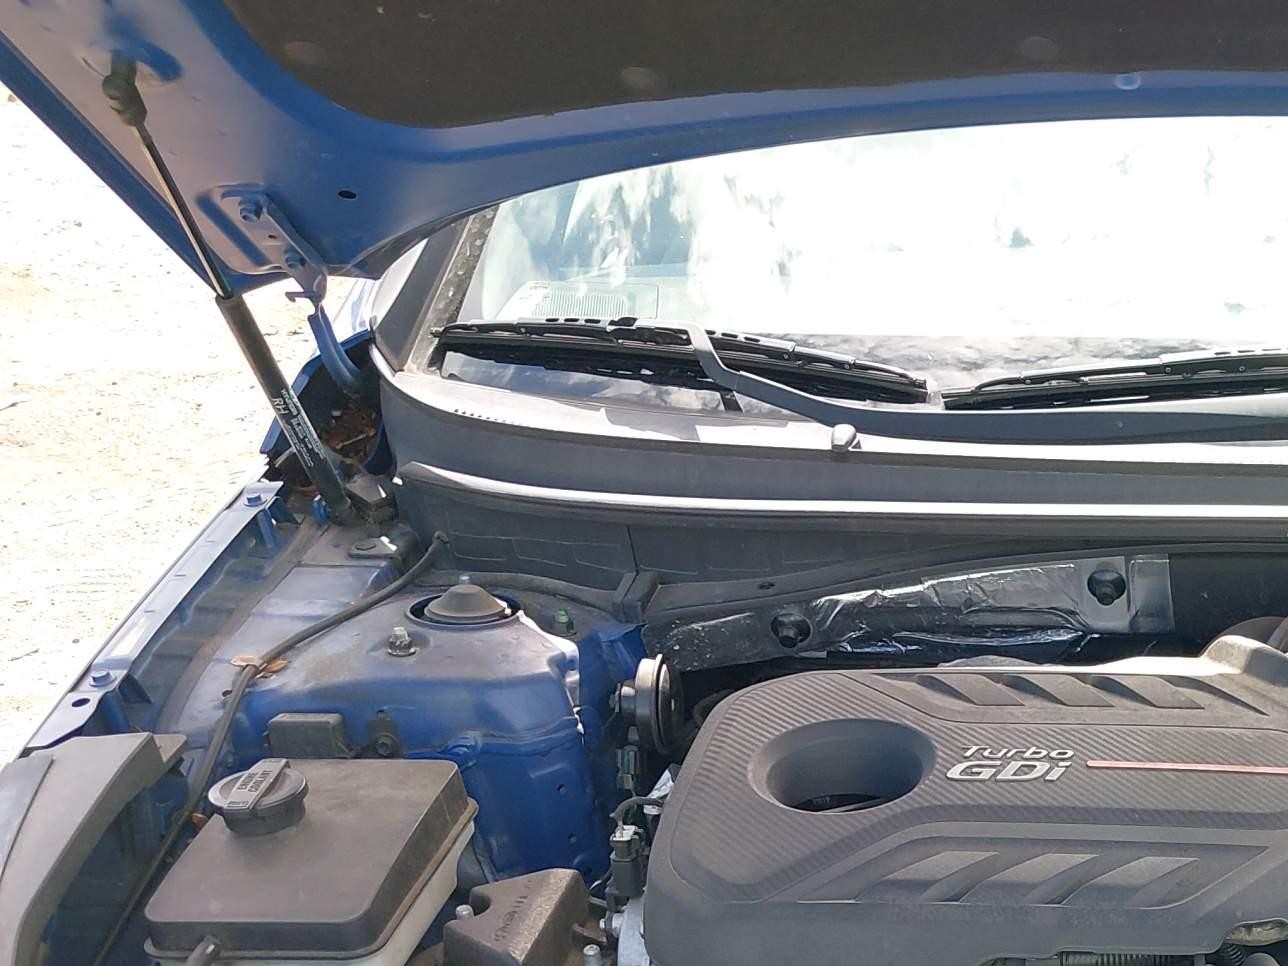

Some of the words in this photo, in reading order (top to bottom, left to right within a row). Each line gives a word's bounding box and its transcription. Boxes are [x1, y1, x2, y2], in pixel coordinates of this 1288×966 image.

[272, 397, 290, 414] RH
[961, 745, 1075, 760] Turbo
[945, 760, 1072, 782] GDi
